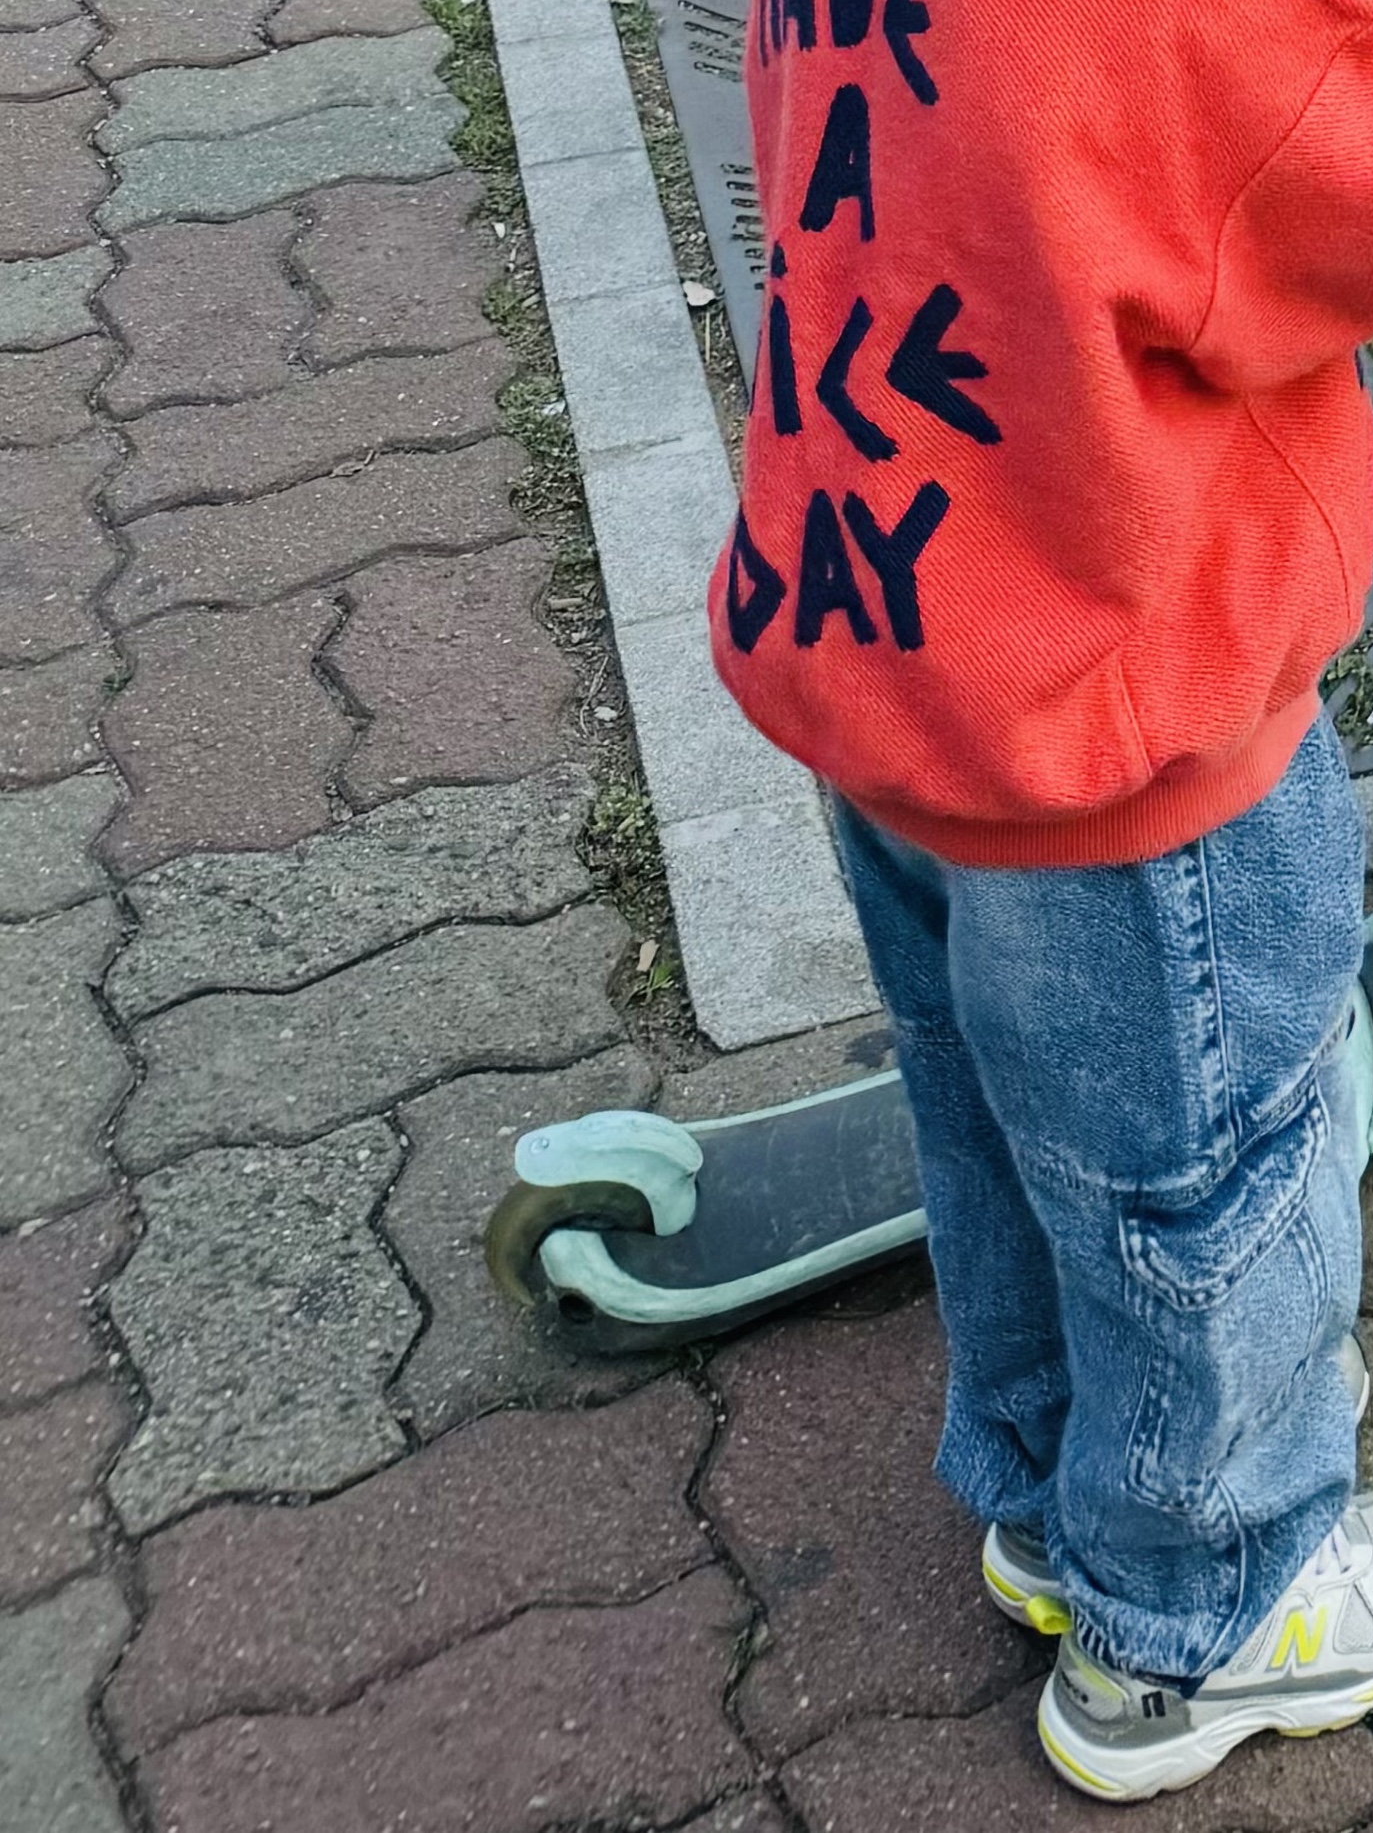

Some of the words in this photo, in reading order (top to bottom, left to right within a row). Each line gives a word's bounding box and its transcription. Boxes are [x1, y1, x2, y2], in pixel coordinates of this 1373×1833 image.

[799, 83, 876, 243] A
[755, 239, 1004, 463] ICE
[725, 480, 951, 655] DAY
